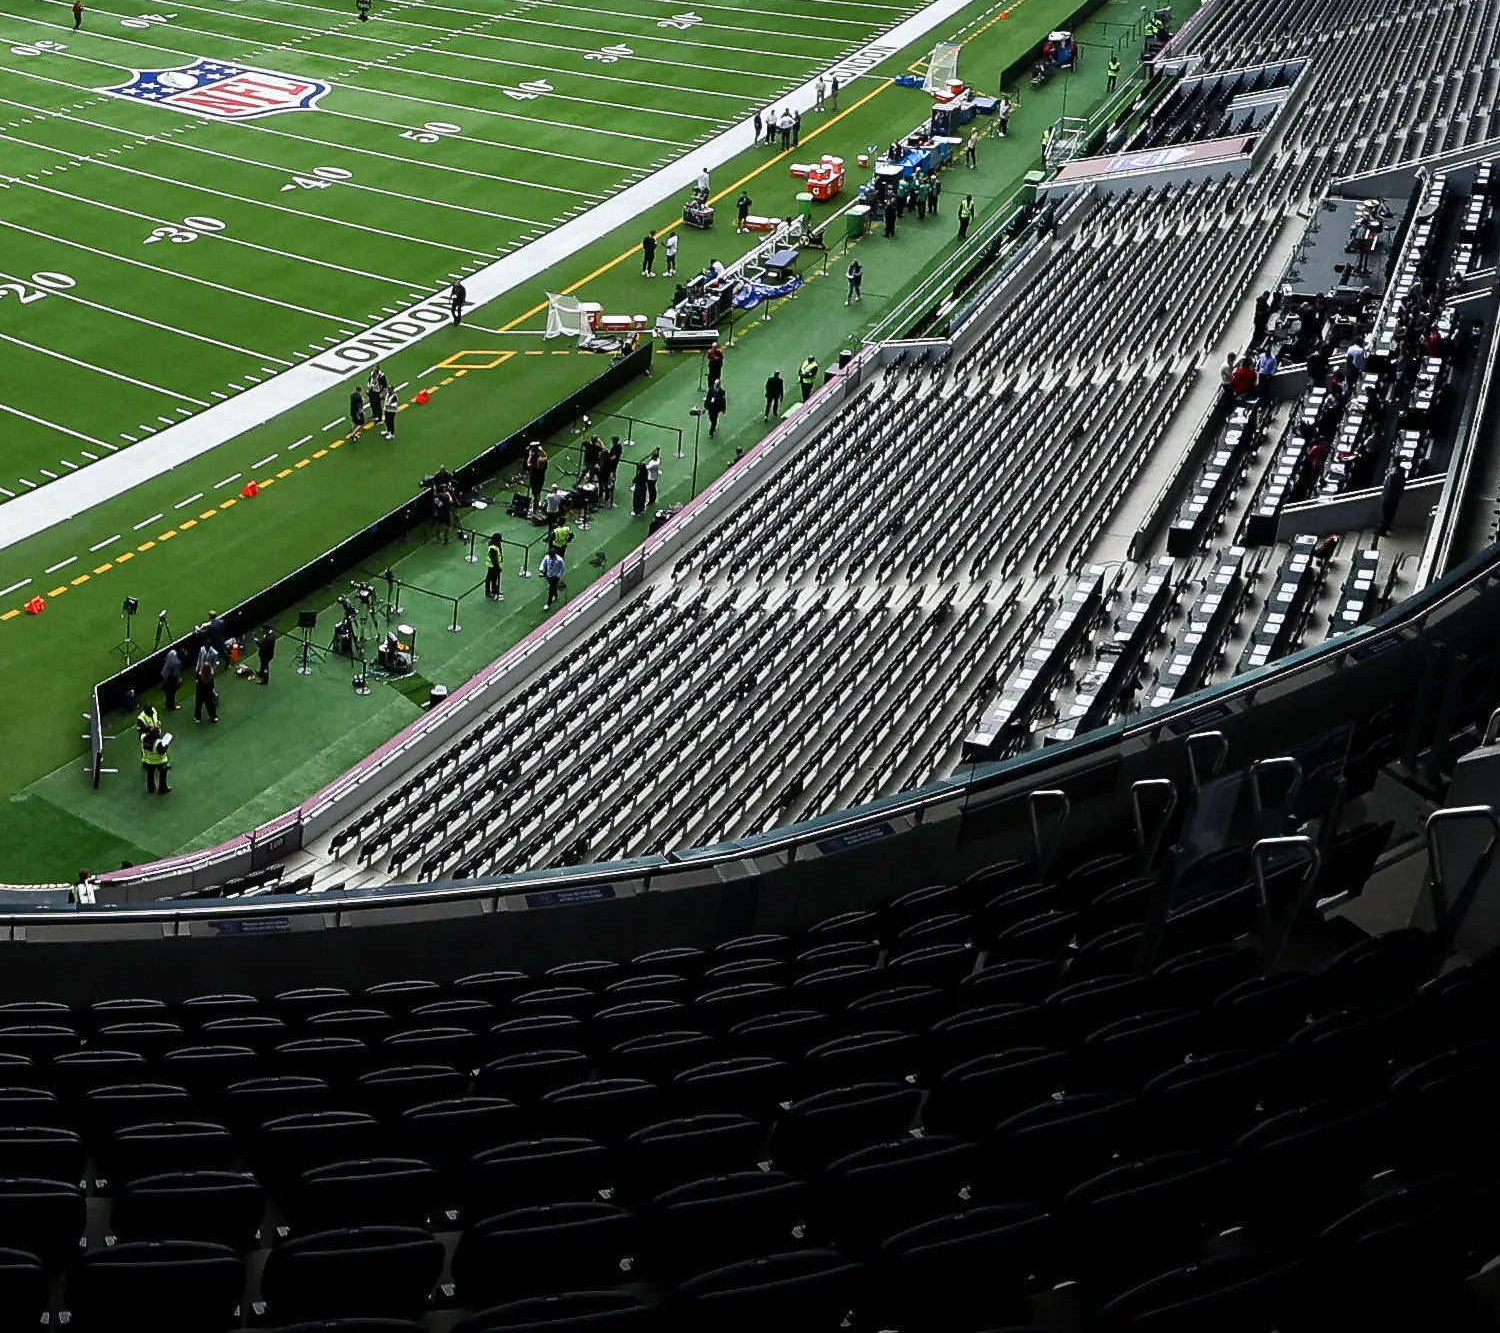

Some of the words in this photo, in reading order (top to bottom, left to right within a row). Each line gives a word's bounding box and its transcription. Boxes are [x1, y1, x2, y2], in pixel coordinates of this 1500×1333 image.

[656, 12, 704, 31] 20
[10, 39, 69, 57] 50
[583, 46, 635, 64] 30
[173, 77, 312, 115] NFL
[502, 79, 555, 101] 40
[399, 121, 462, 144] 50
[291, 165, 354, 190] 40
[150, 215, 227, 244] 30
[308, 294, 478, 375] LONDON
